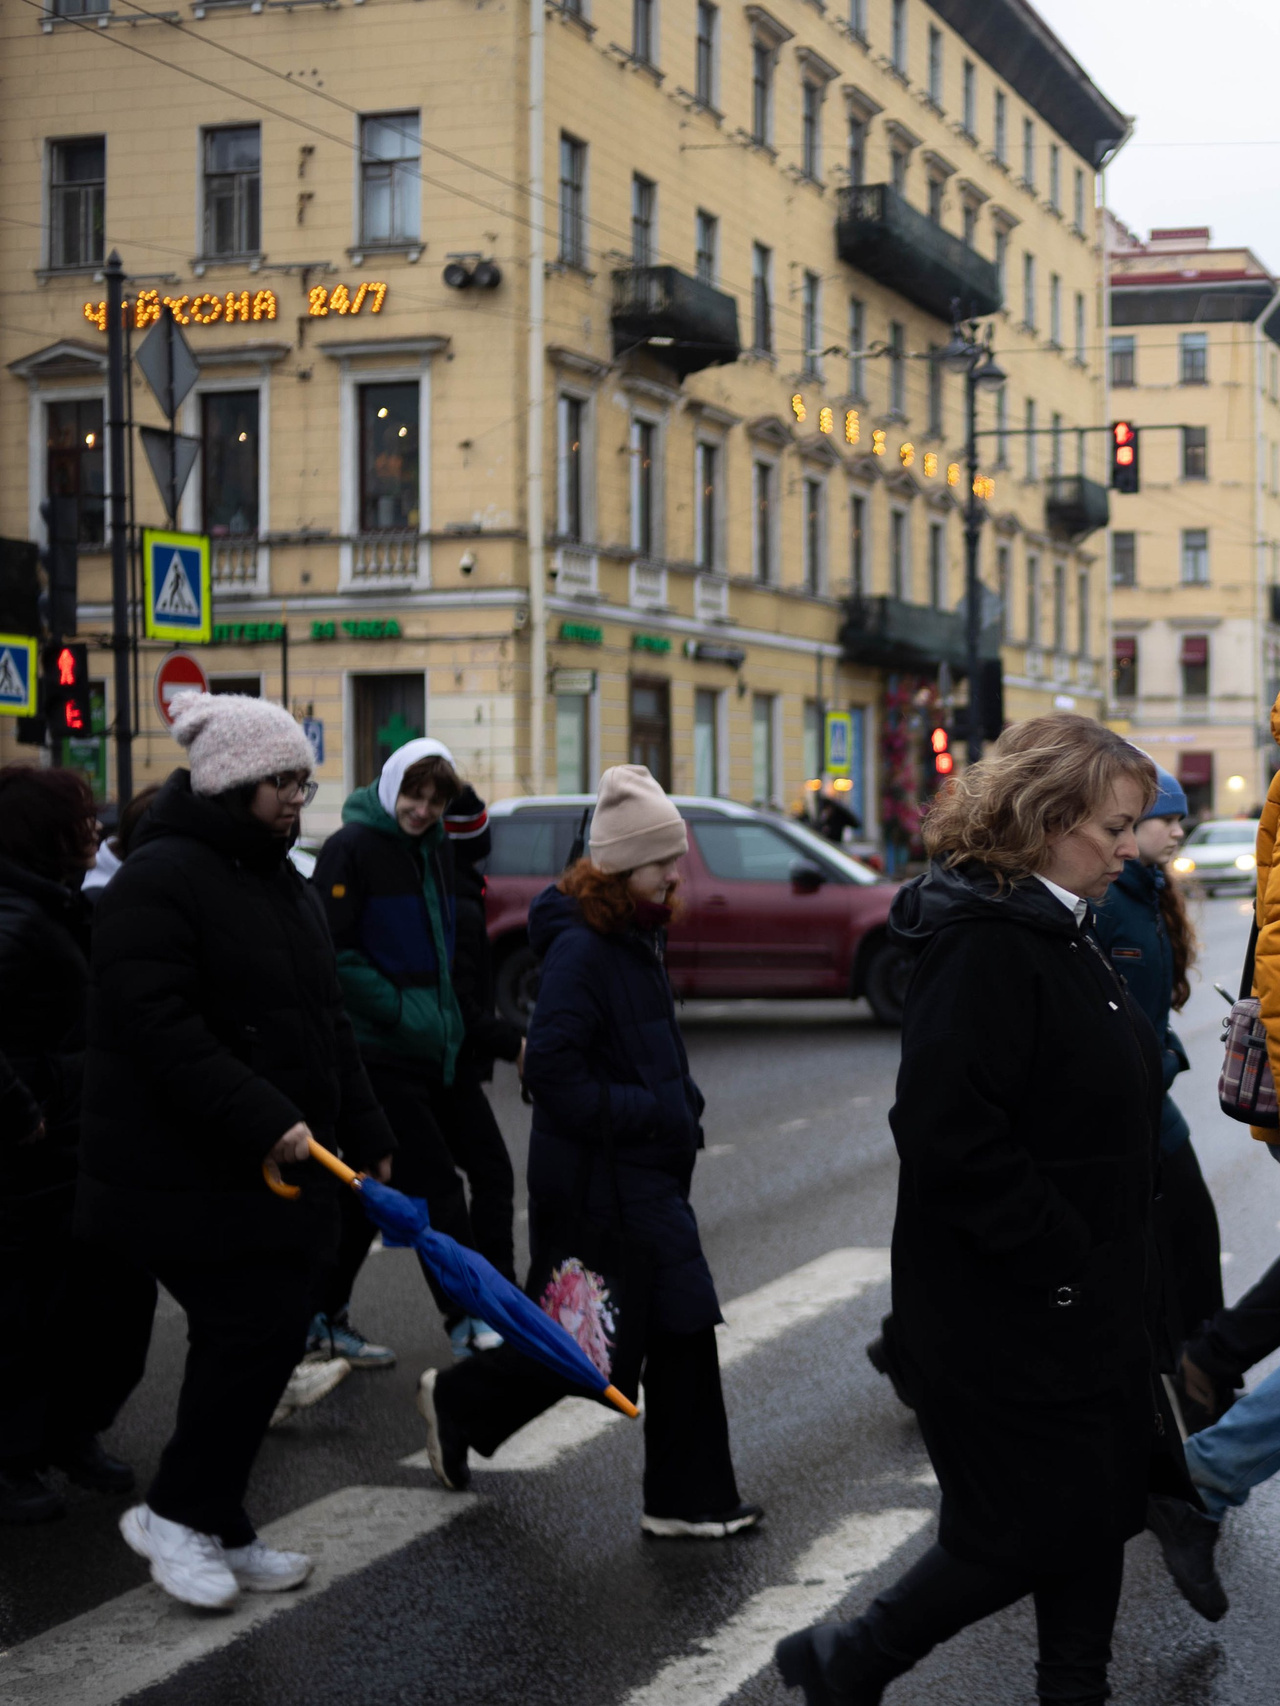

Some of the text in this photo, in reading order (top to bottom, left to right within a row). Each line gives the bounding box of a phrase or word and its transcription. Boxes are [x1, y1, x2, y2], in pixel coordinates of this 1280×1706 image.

[84, 282, 387, 331] ЧЙХОНА 24/7
[213, 621, 284, 641] ПТЕКА
